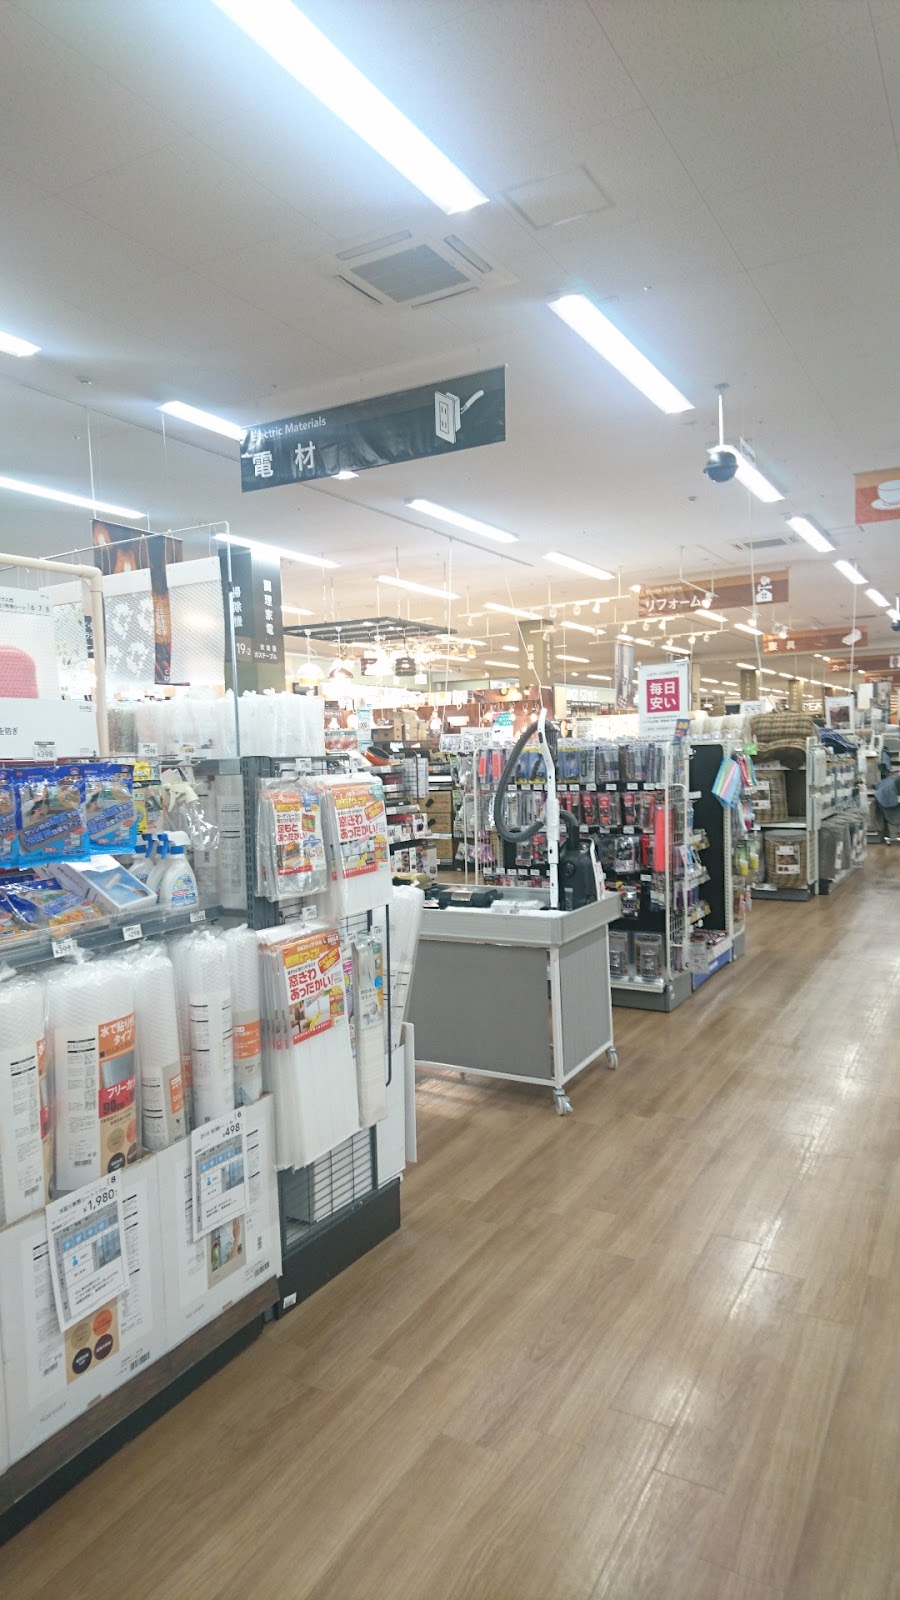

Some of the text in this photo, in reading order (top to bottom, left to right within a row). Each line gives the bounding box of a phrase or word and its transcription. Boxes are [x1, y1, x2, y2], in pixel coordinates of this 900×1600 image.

[284, 416, 327, 434] Materials
[645, 595, 702, 612] リフォーム
[649, 681, 676, 696] 毎日
[649, 696, 677, 711] 安い
[277, 823, 299, 834] 足もと
[288, 967, 317, 989] 窓ぎわ
[222, 1122, 240, 1138] ¥498
[83, 1188, 115, 1213] ¥1,980
